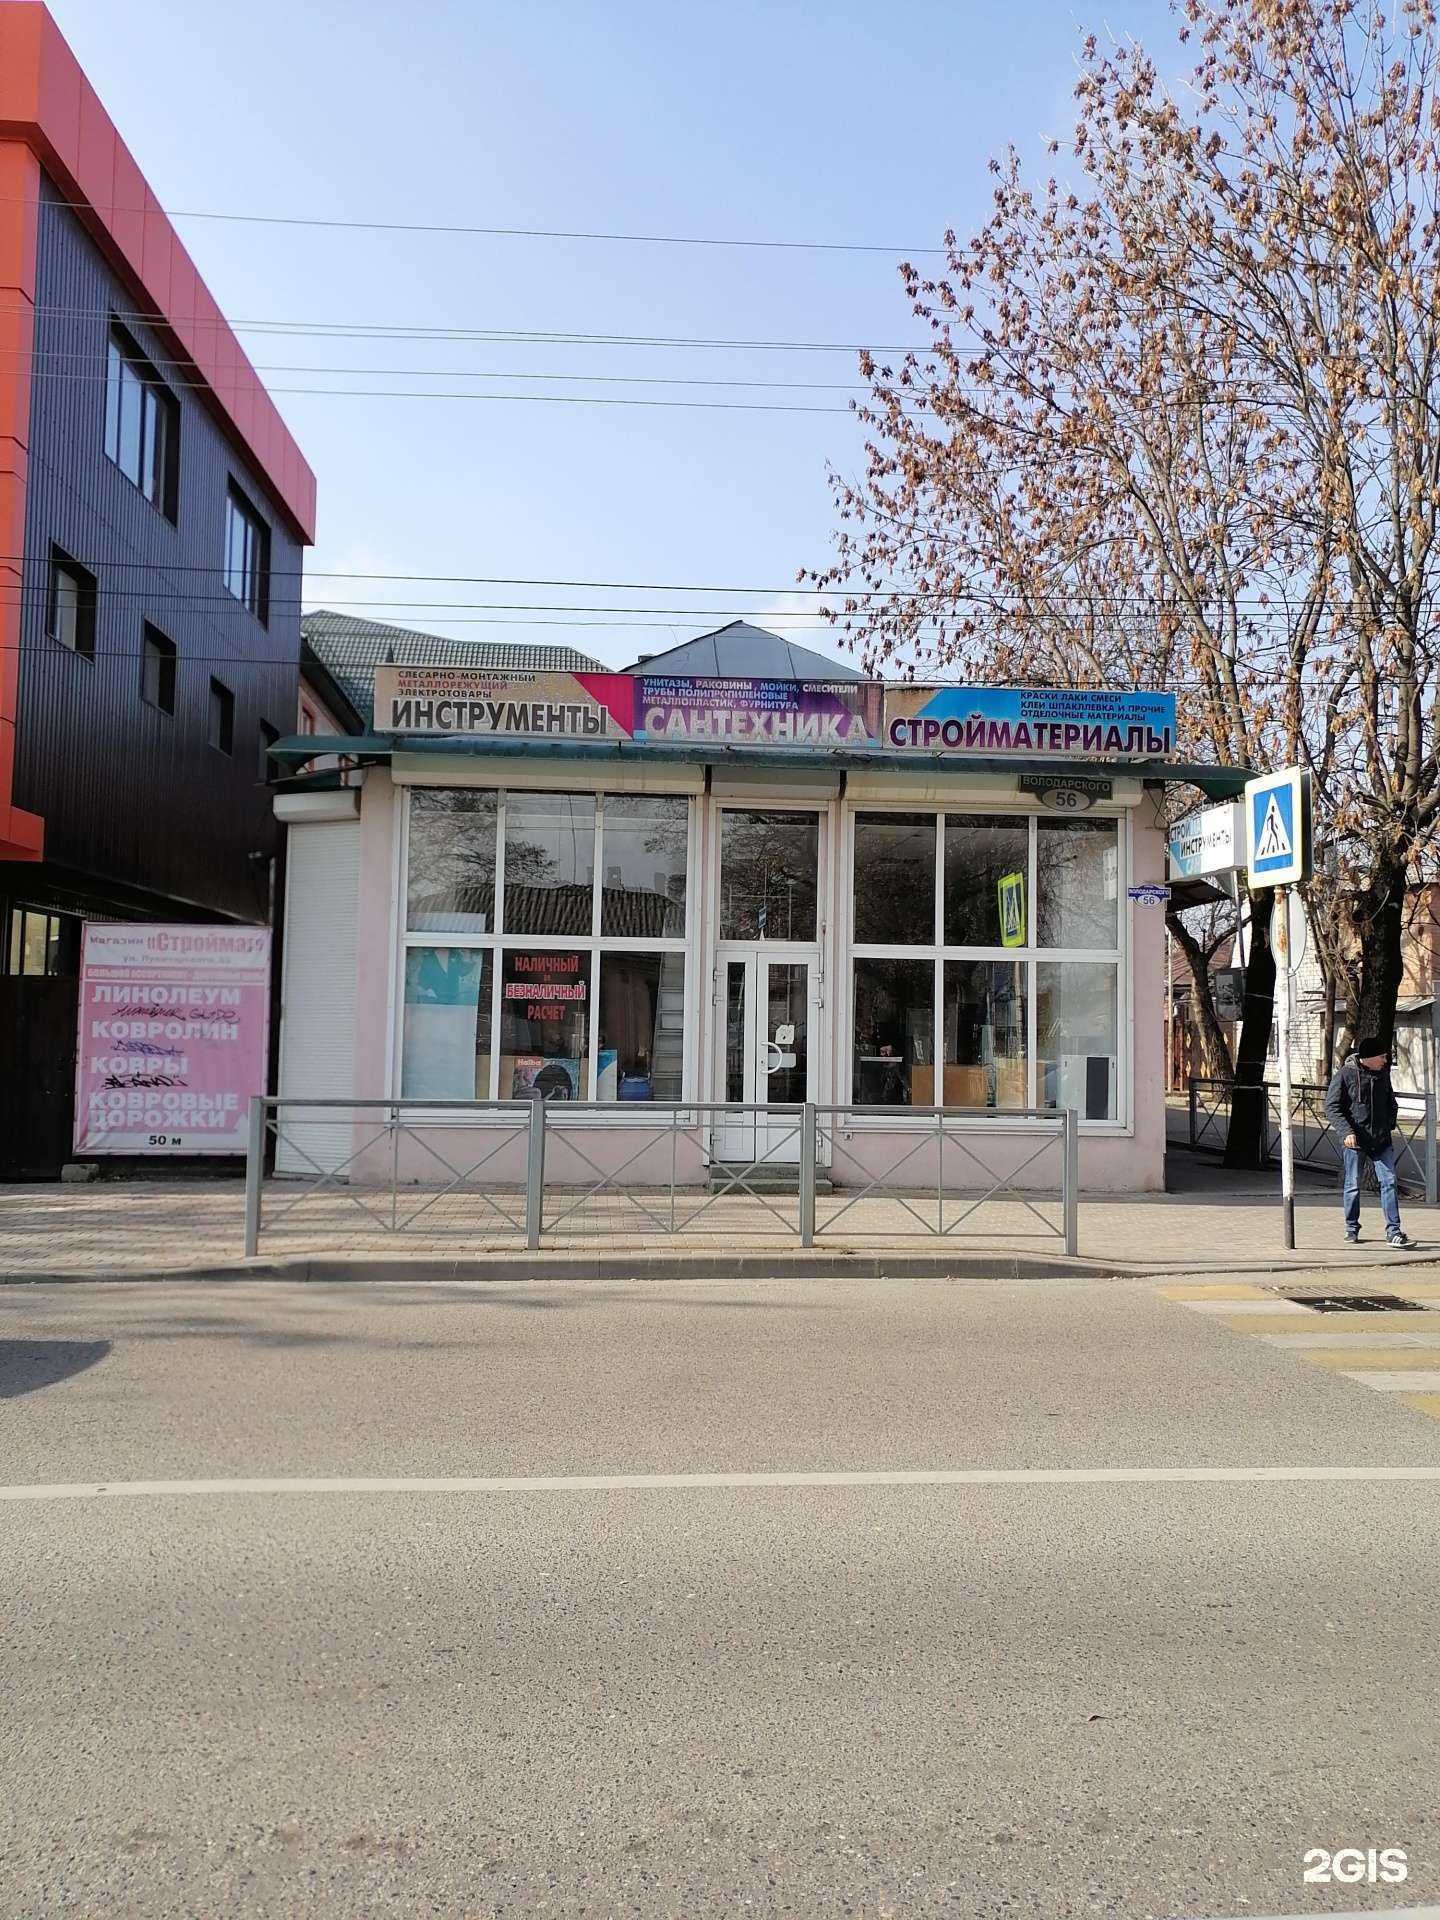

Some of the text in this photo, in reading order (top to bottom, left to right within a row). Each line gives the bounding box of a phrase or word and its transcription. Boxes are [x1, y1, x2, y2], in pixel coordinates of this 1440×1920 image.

[398, 671, 536, 682] СЛЕСАРНО-МОНТАЖНЫЙ
[643, 678, 692, 689] УНИТАЗЫ,
[398, 680, 508, 691] МЕТАЛЛОРЕЖУЩИЙ
[398, 689, 492, 698] ЭЛЕКТРОТОВАРЫ
[642, 687, 675, 696] ТРУБЫ
[1020, 692, 1122, 703] КРАСКИ ЛАКИ СМЕСИ
[391, 700, 607, 735] ИНСТРУМЕНТЫ
[1020, 710, 1146, 721] ОТДЕЛОЧНЫЕ МАТЕРИАЛЫ
[1128, 705, 1166, 714] ПРОЧИЕ
[644, 707, 870, 744] САНТЕХНИКА
[889, 711, 1171, 753] СТРОЙМАТЕРИАЛЫ
[1023, 776, 1110, 792] ВОЛОДАРСКОГО
[1055, 791, 1078, 808] 56
[1143, 896, 1155, 905] 56
[515, 955, 579, 973] НАЛИЧНЫЙ
[91, 985, 241, 1005] ЛИНОЛЕУМ
[506, 981, 586, 1000] БЕЗНАЛИЧНЫЙ
[527, 1005, 566, 1021] РАСЧЕТ
[91, 1021, 238, 1041] КОВРОЛИН
[90, 1056, 188, 1074] КОВРЫ
[88, 1092, 238, 1111] КОВРОВЫЕ
[88, 1110, 226, 1130] ДОРОЖКИ
[149, 1136, 166, 1146] 50
